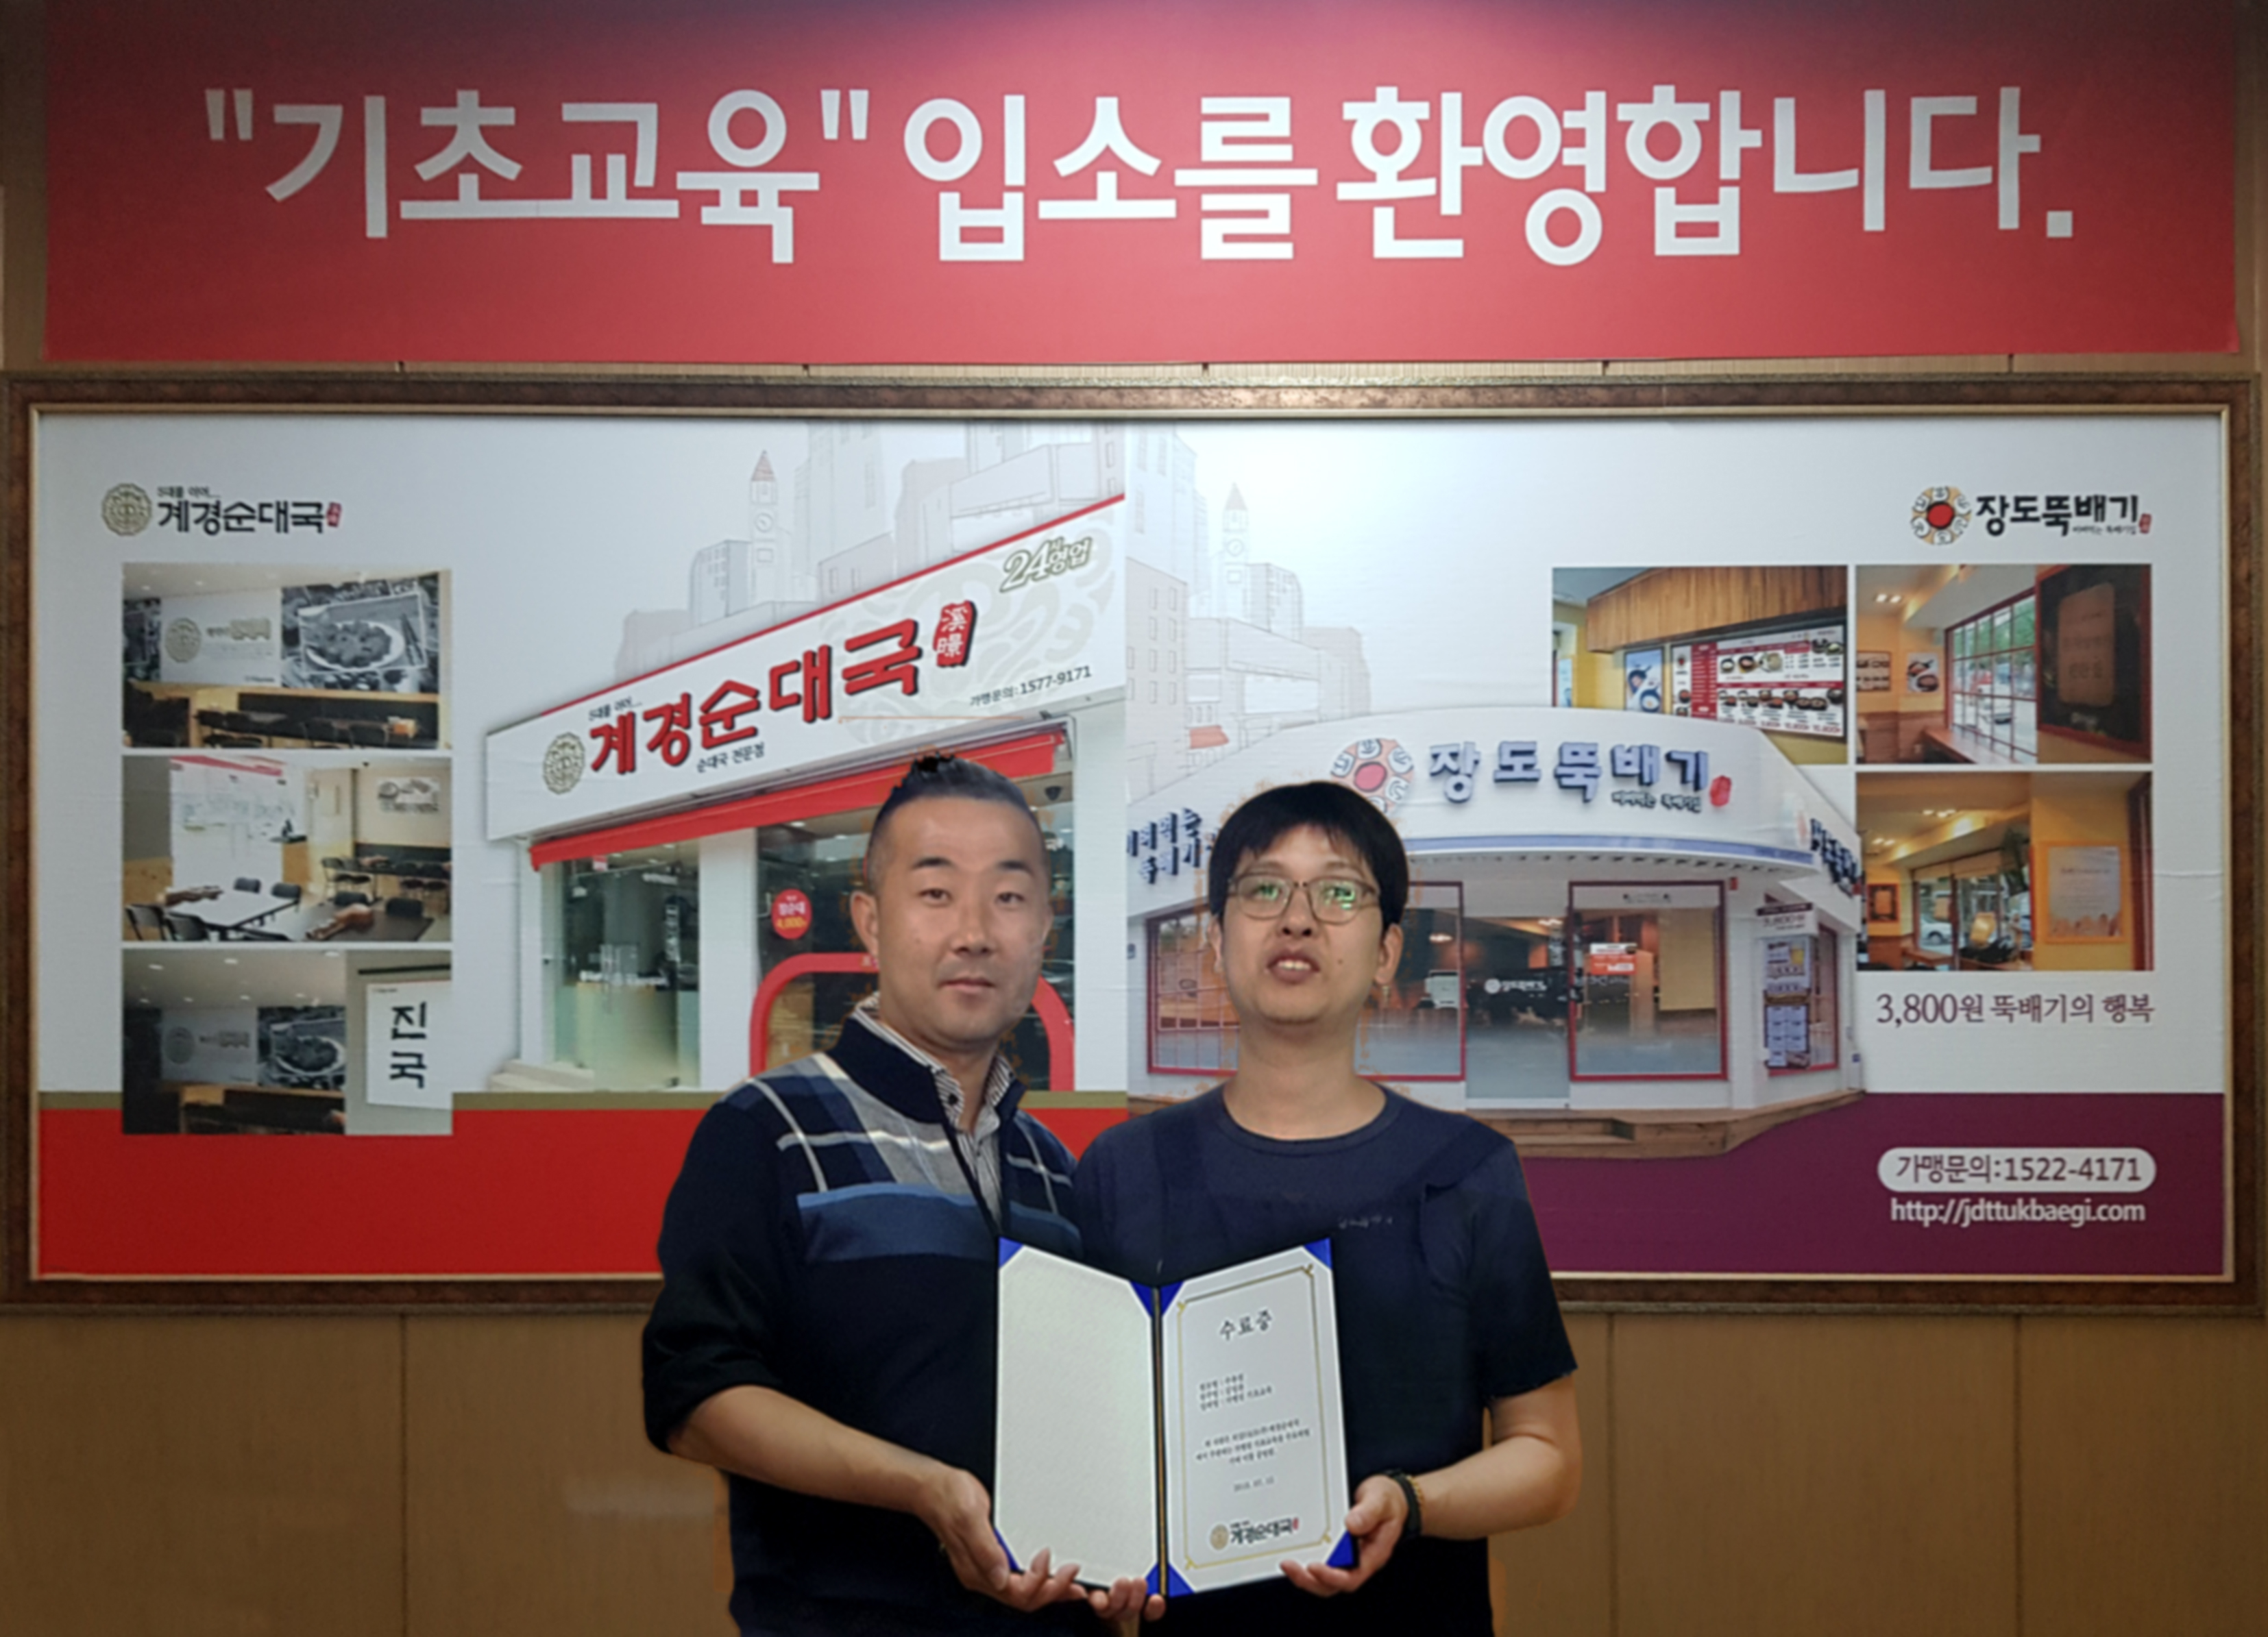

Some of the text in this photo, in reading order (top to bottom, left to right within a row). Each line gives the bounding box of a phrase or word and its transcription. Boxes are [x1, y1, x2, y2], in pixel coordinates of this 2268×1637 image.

[205, 85, 2073, 266] "기초교육" 입소를 환영합니다.
[158, 500, 325, 536] 계경순대국
[1975, 495, 2138, 537] 장도뚝배기
[589, 619, 923, 775] 계경순대국
[1429, 741, 1710, 803] 장도뚝배기
[1876, 994, 2156, 1027] 3,800원 뚝배기의 행복
[389, 1001, 427, 1089] 진국
[1890, 1198, 2147, 1228] http://jdttukbaegi.com
[1219, 1309, 1273, 1340] 수료증
